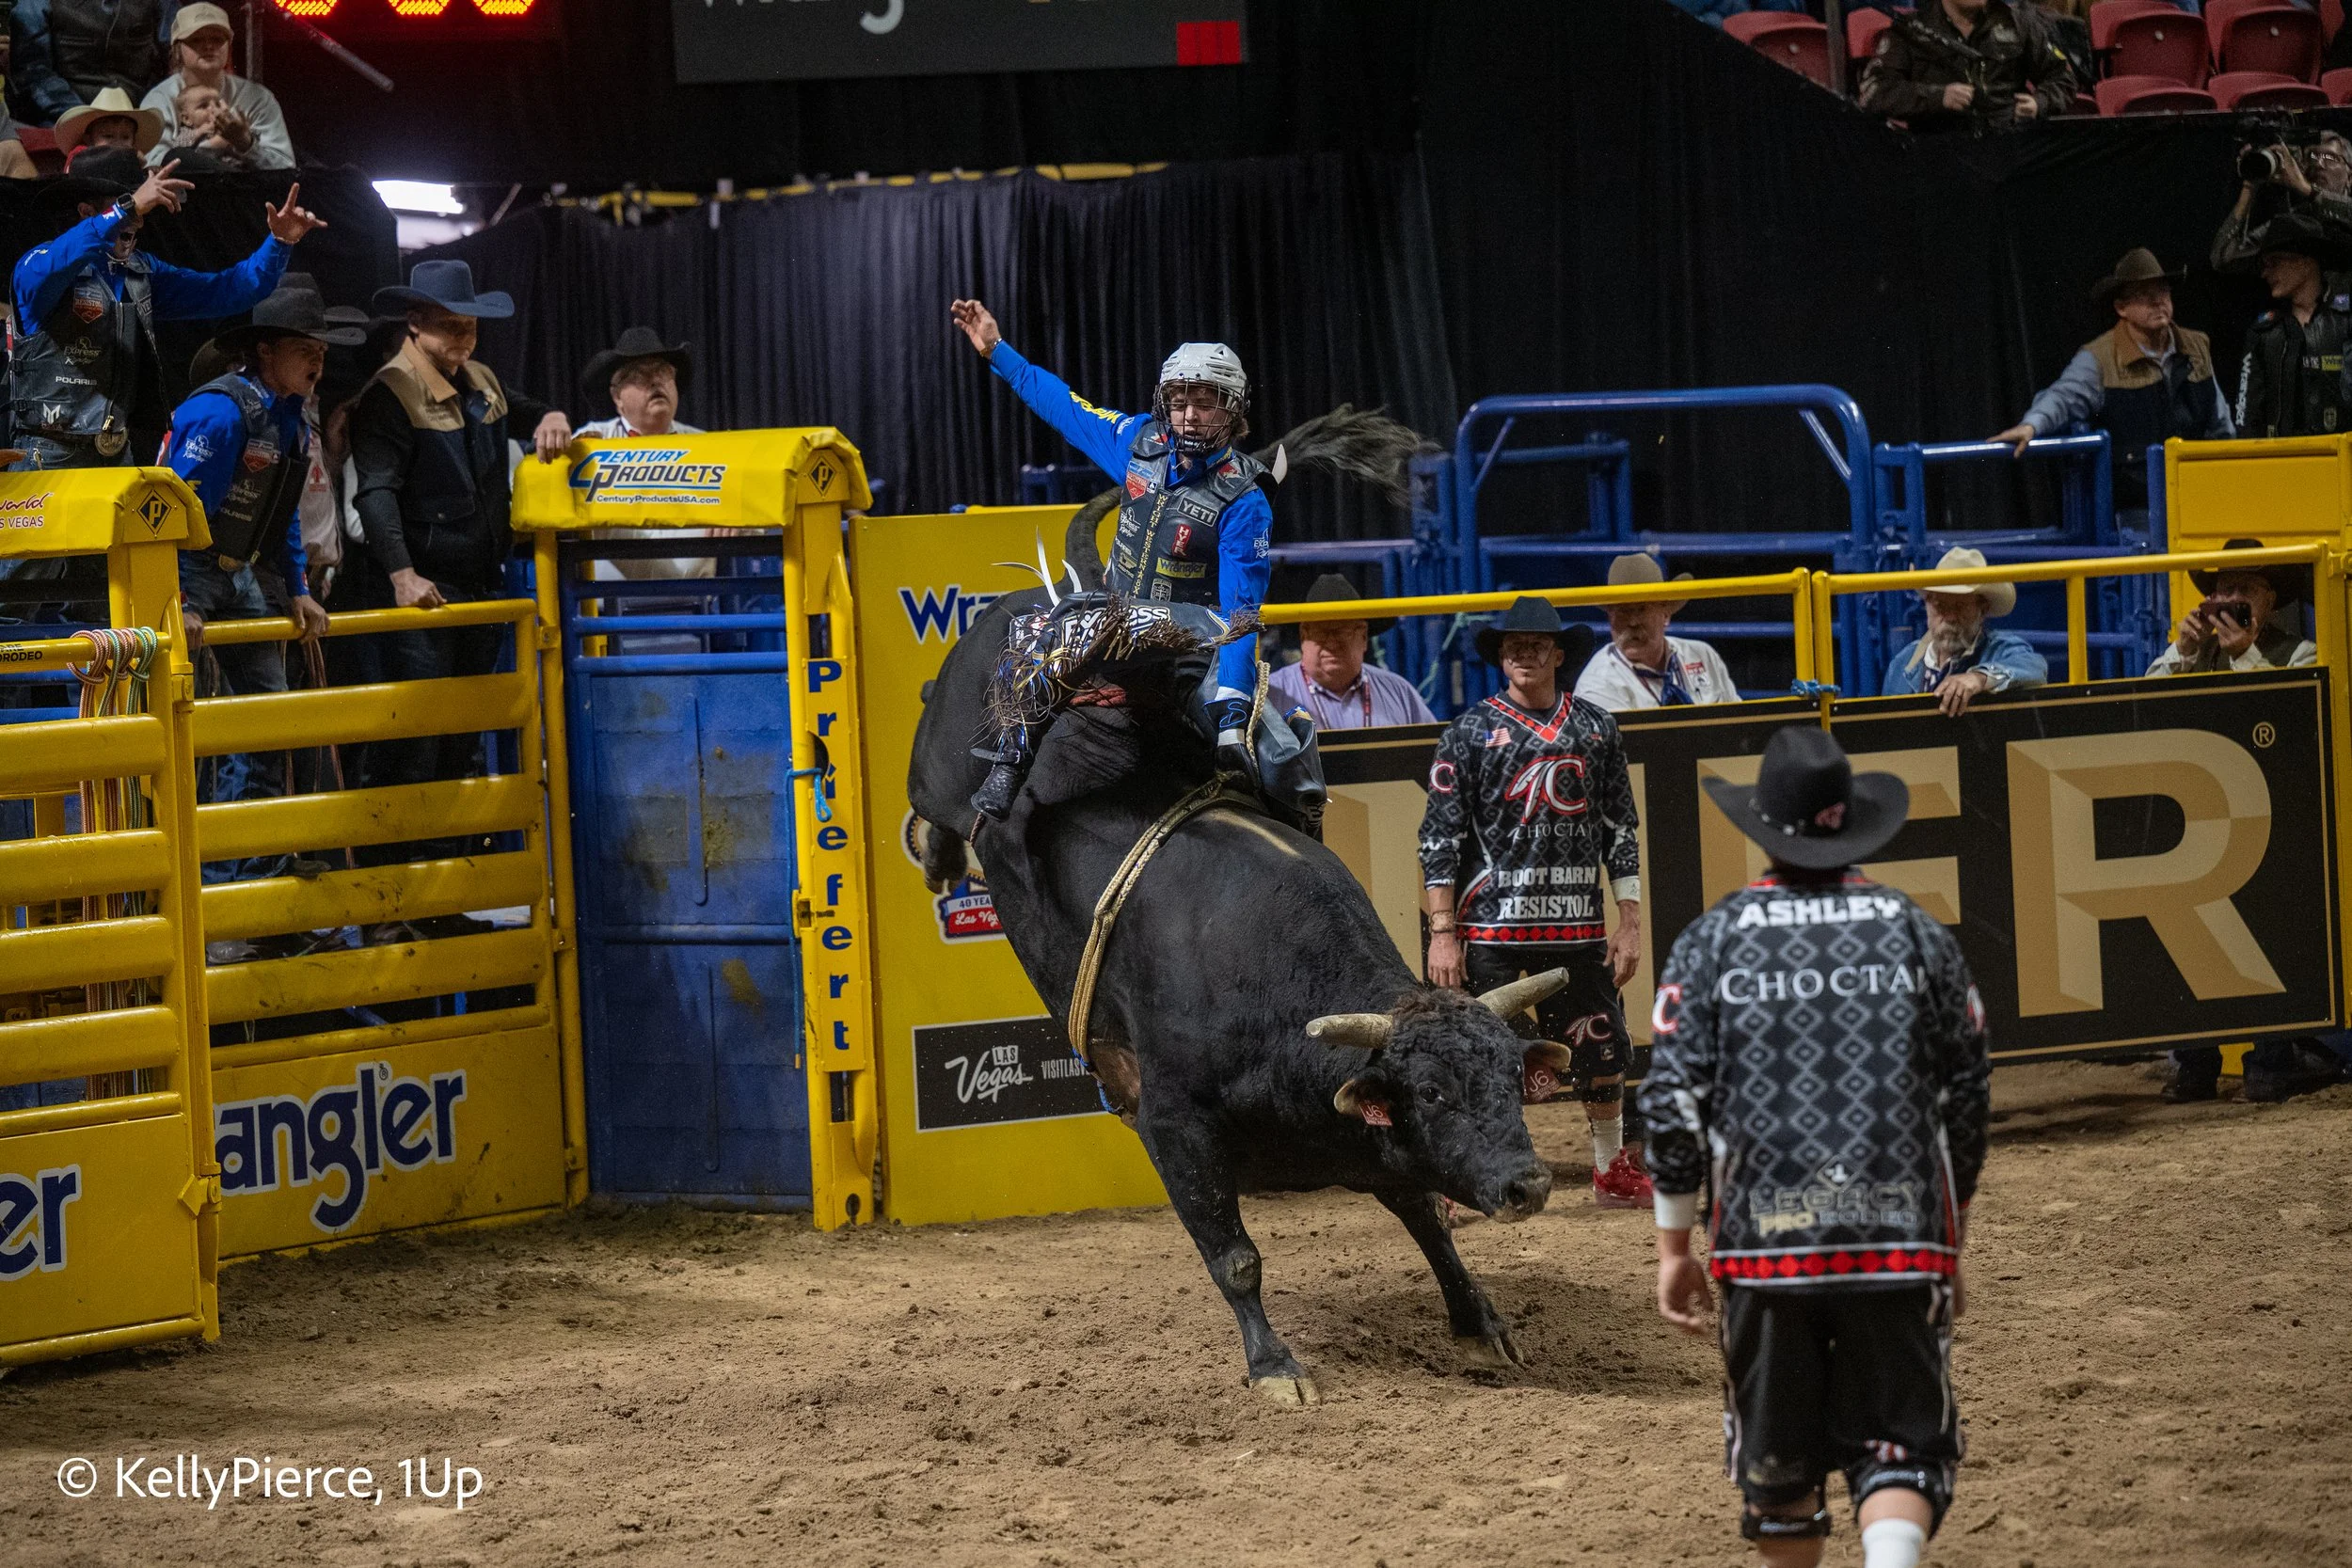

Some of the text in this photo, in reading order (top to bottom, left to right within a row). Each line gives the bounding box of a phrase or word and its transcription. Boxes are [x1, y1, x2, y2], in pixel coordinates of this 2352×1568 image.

[569, 451, 689, 488] CENTURY
[586, 465, 726, 502] PRODUCTS
[596, 495, 721, 504] CenturyProductsUSA.com
[1183, 499, 1216, 523] YETI
[8, 515, 44, 528] VEGAS
[1172, 525, 1190, 557] HYER
[1498, 866, 1597, 888] BOOT BARN
[959, 900, 973, 910] 40
[1497, 895, 1595, 921] RESISTOL
[1736, 895, 1901, 929] ASHLEY
[954, 911, 977, 926] Las
[994, 1049, 1017, 1063] LAS
[945, 1051, 1034, 1103] Vegas
[1529, 1069, 1549, 1093] J6
[1365, 1104, 1384, 1118] J6
